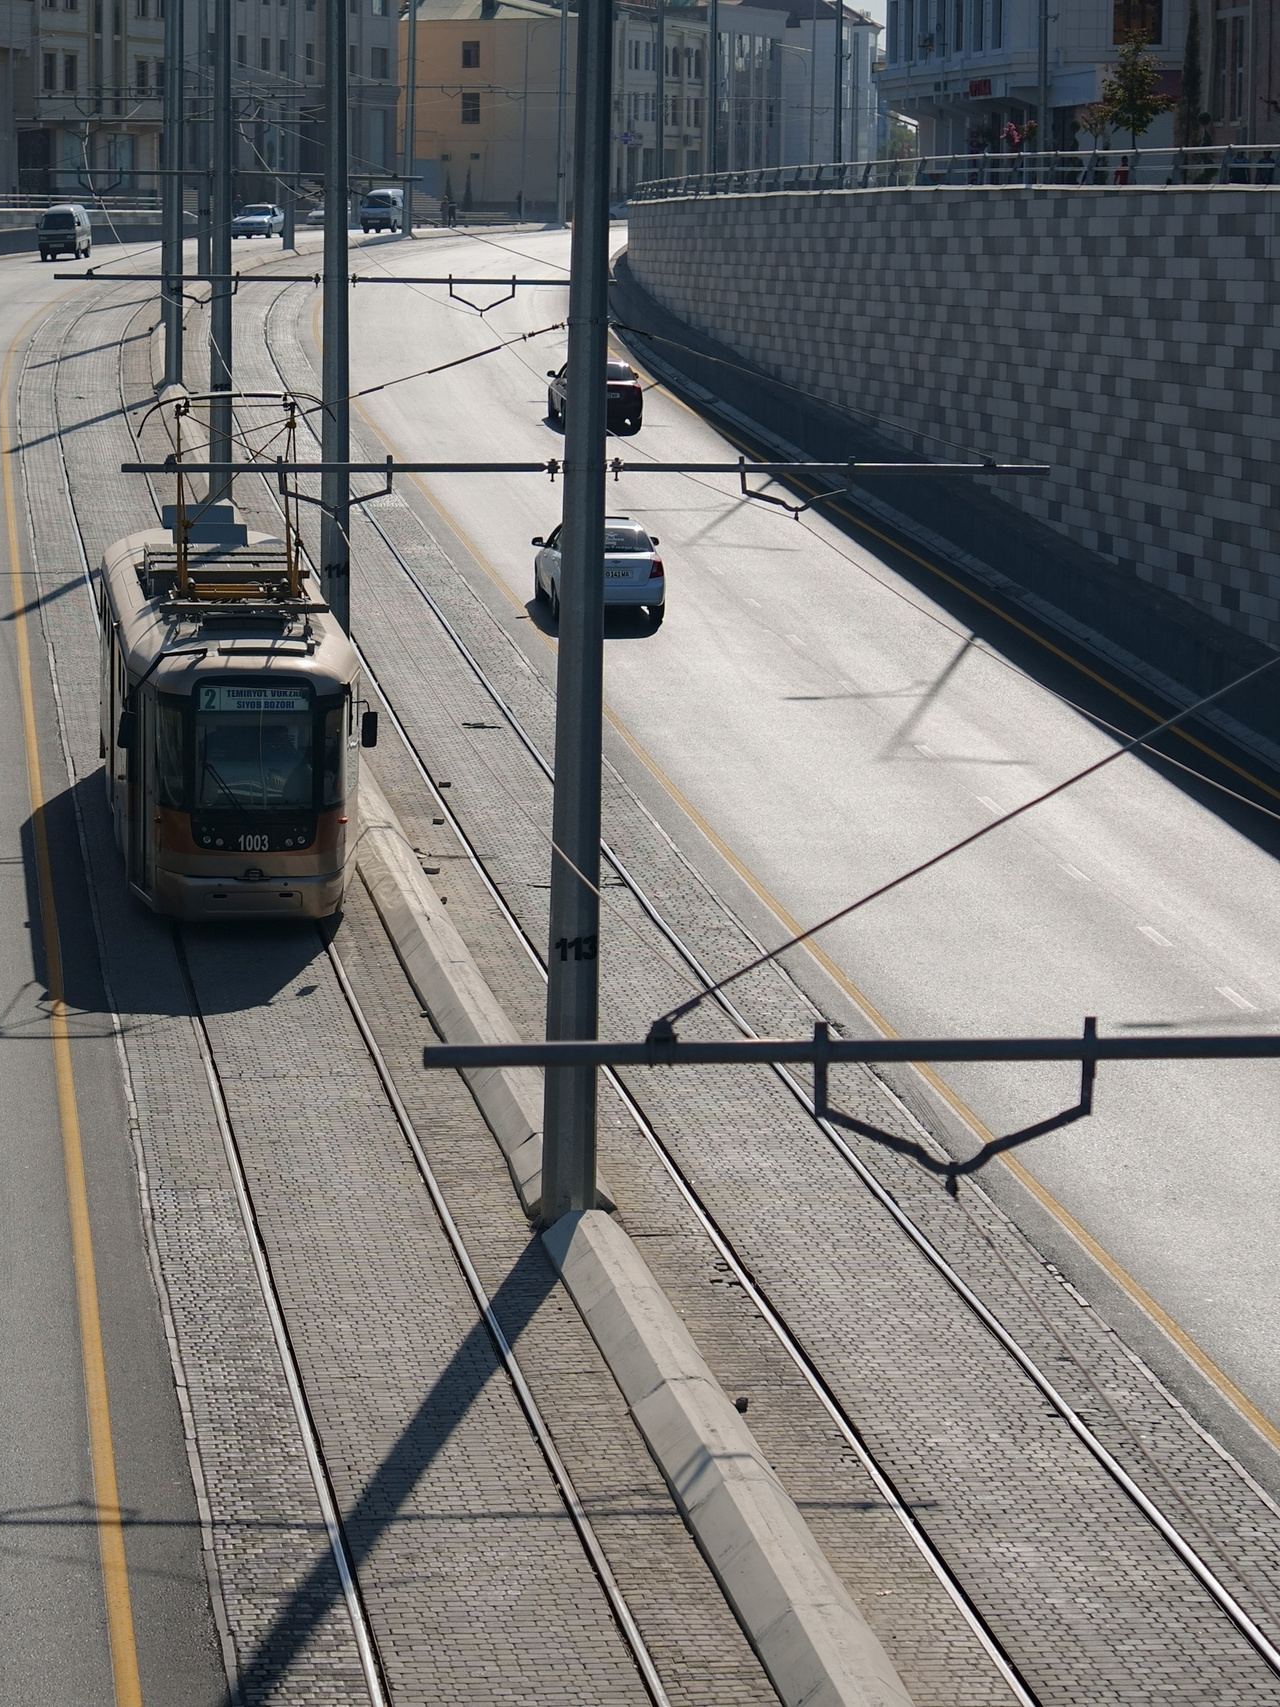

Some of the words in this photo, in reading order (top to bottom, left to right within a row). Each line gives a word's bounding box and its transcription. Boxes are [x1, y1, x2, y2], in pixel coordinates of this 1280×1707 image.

[204, 688, 216, 709] 2
[236, 701, 262, 709] SIYOB
[263, 701, 295, 709] BOZORI
[239, 834, 269, 851] 1003
[555, 935, 597, 961] 113
